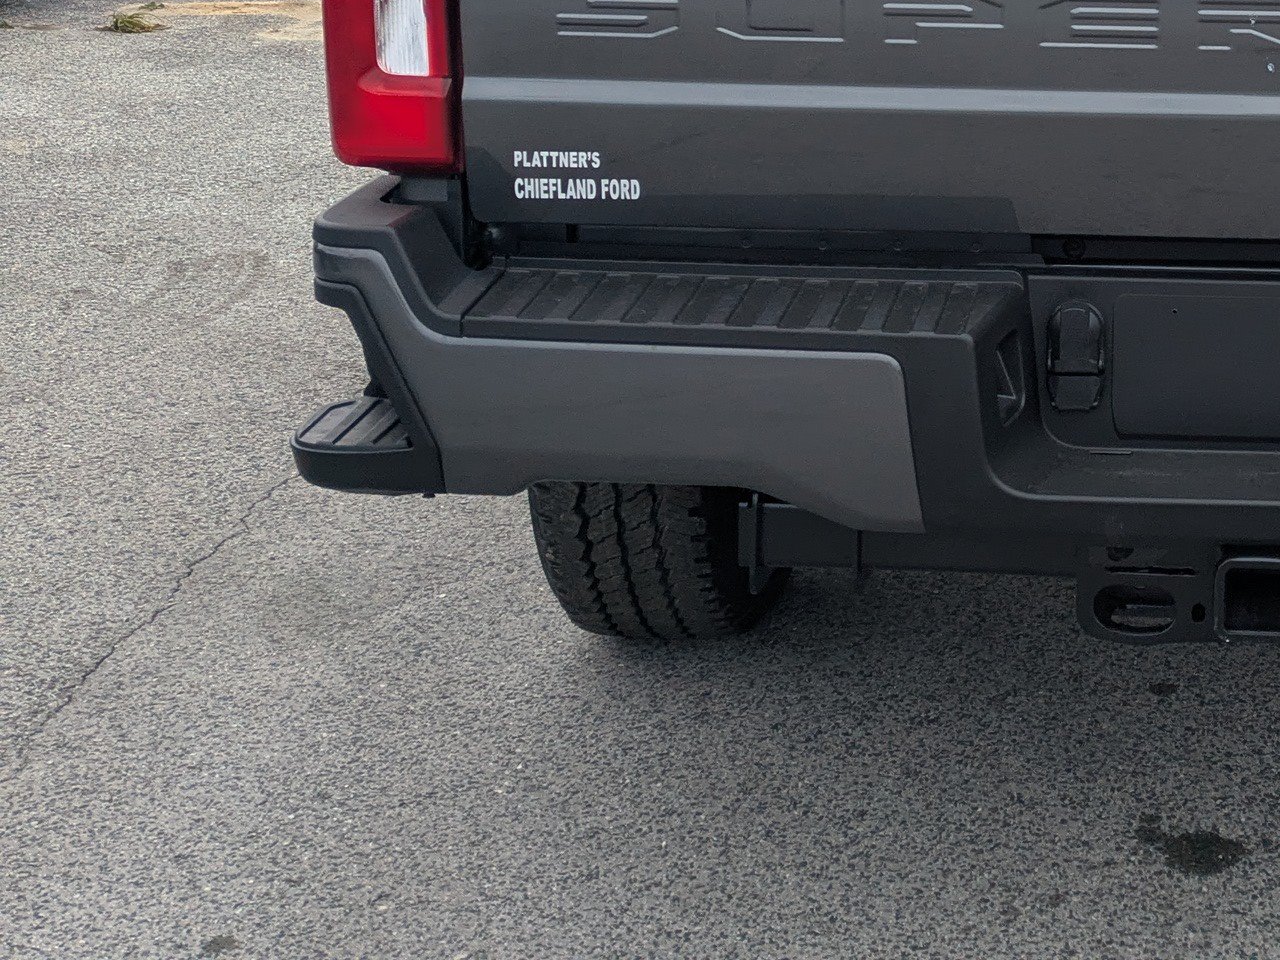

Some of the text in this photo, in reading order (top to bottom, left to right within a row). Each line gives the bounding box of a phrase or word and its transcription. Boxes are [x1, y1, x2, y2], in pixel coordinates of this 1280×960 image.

[513, 150, 601, 169] PLATTNER'S
[514, 177, 641, 200] CHIEFLAND FORD
